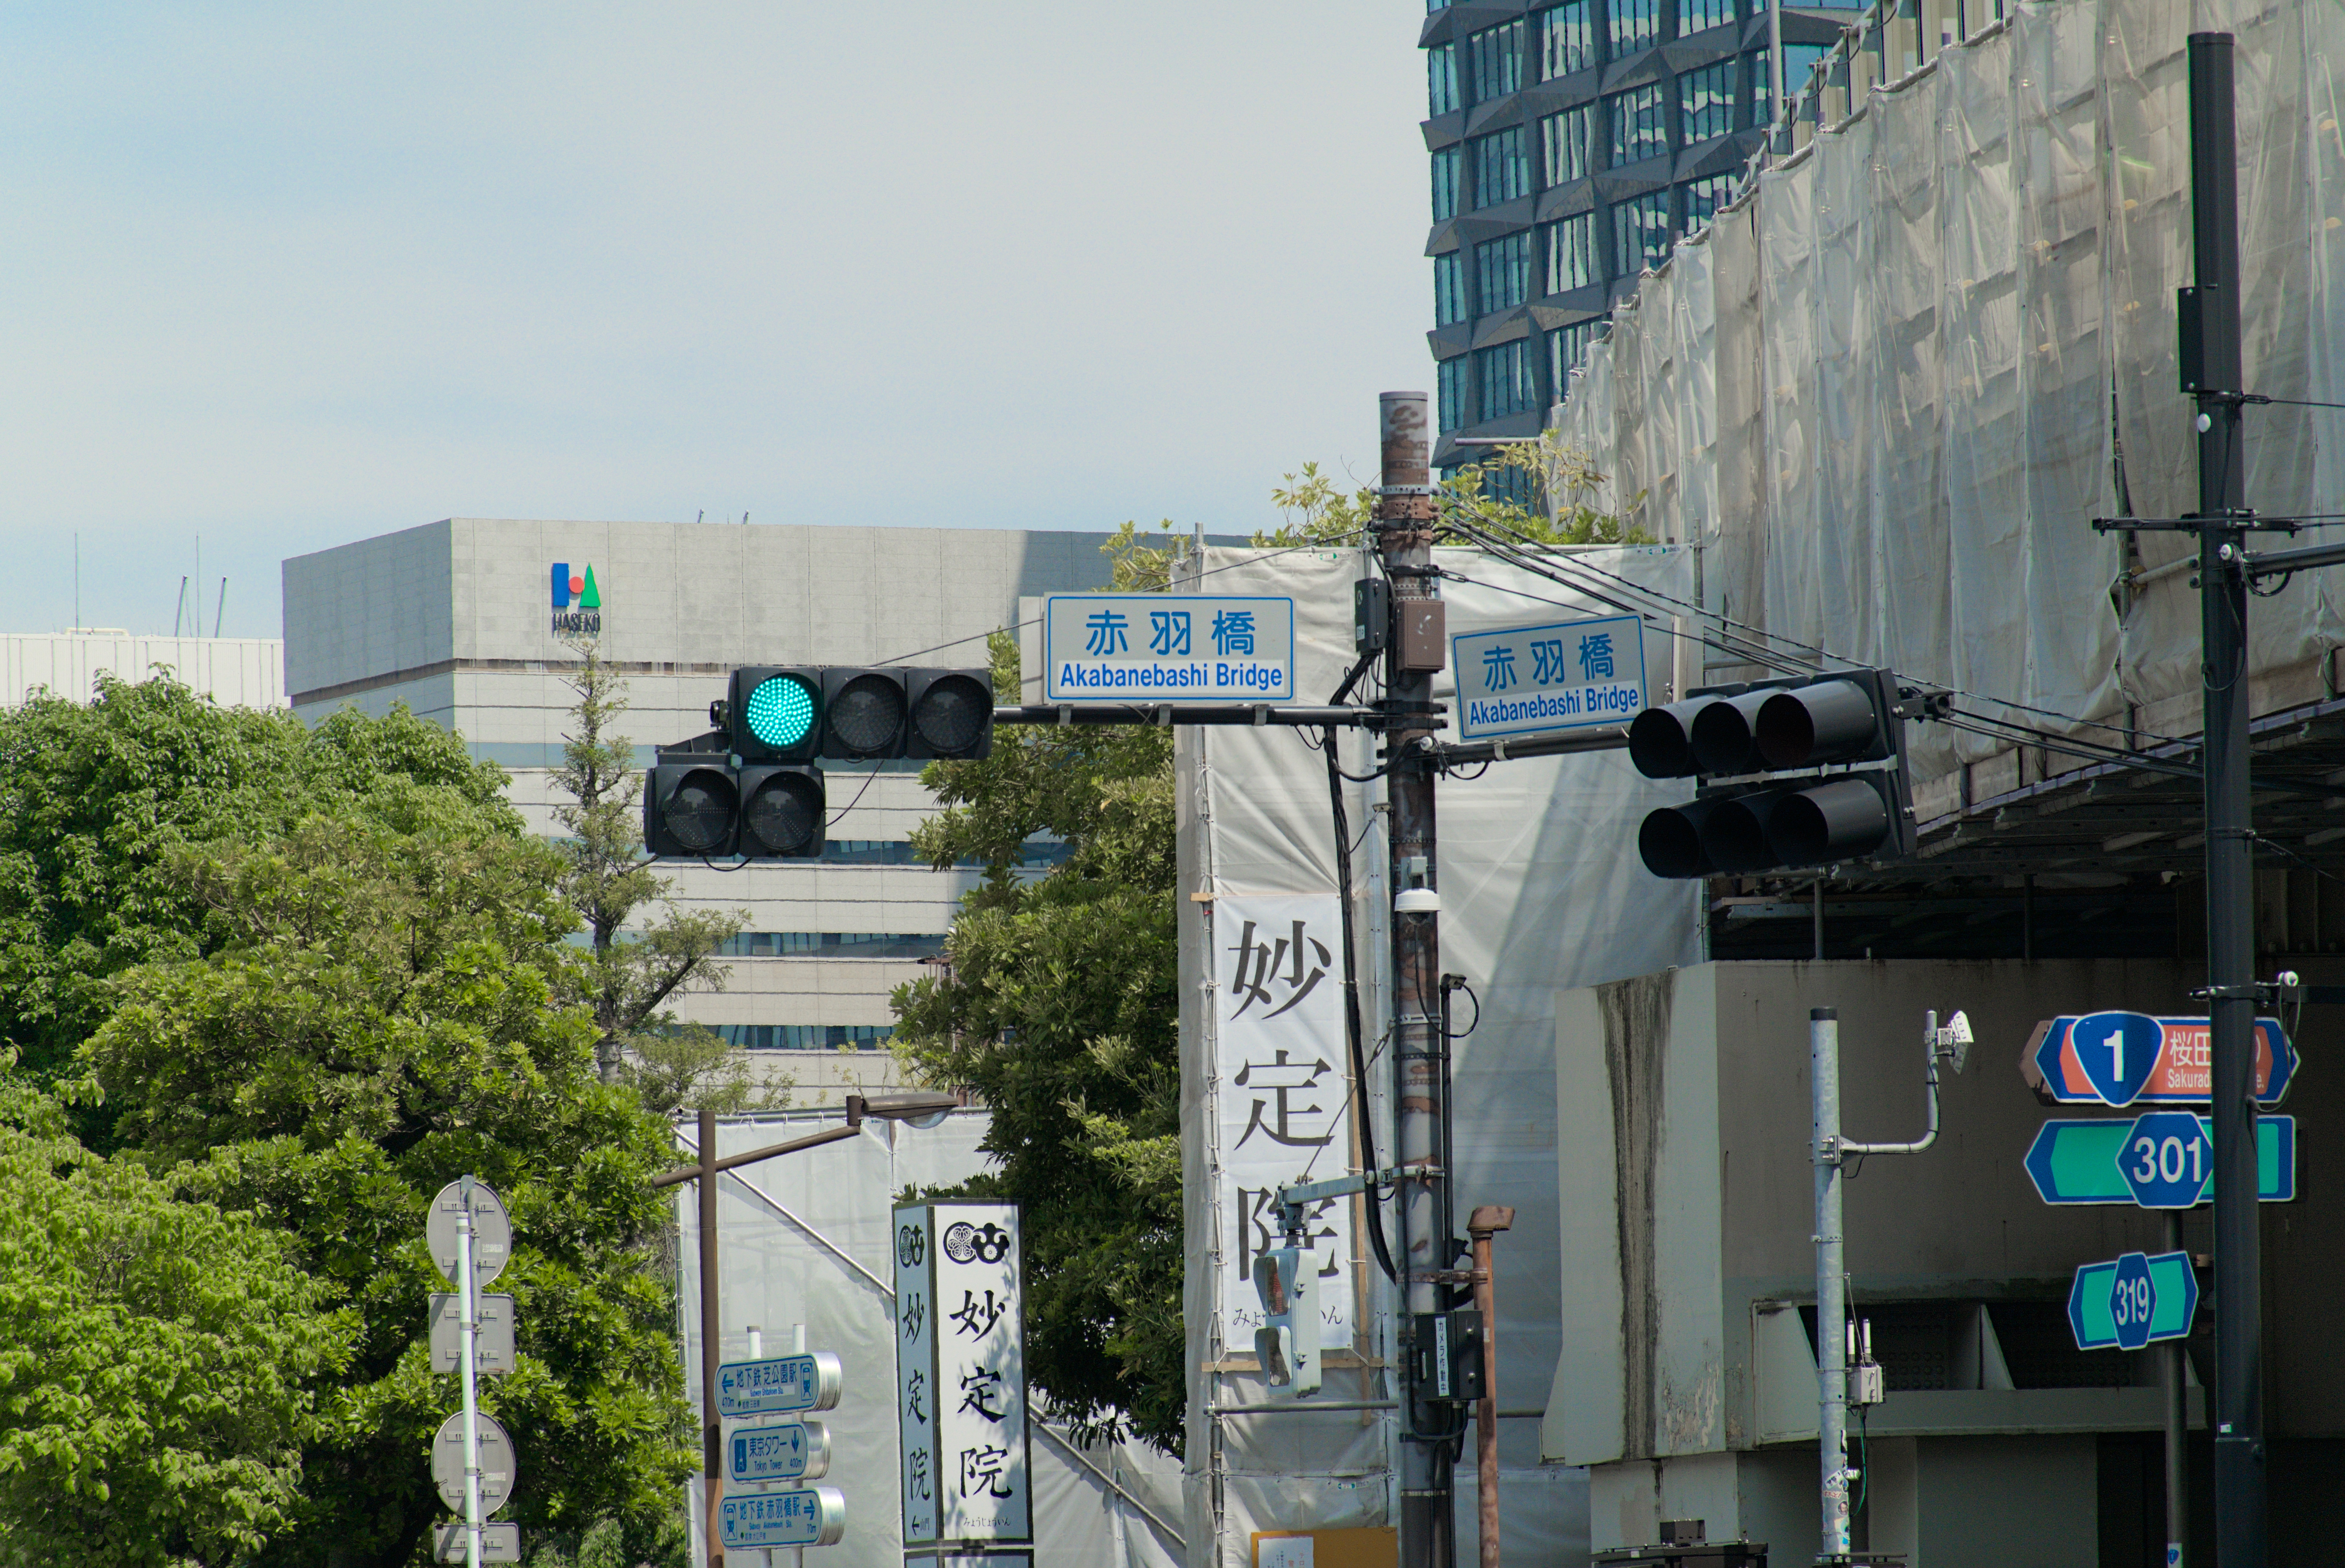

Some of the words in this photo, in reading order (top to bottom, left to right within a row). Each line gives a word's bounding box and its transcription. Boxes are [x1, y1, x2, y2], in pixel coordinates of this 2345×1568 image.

[553, 613, 600, 631] HASEKO
[1085, 609, 1256, 656] 赤羽橋
[1060, 663, 1208, 687] Akabanebashi
[1216, 663, 1283, 691] Bridge
[1482, 633, 1614, 692] 赤羽橋
[1470, 690, 1581, 726] Akabanebashi
[1585, 685, 1638, 713] Bridge
[2102, 1030, 2124, 1082] 1
[2133, 1136, 2202, 1184] 301
[2116, 1276, 2149, 1326] 319
[1438, 1321, 1447, 1394] カメラ作動中
[722, 1397, 734, 1408] 470m
[902, 1290, 931, 1502] 妙定院
[949, 1289, 1013, 1500] 妙定院
[749, 1436, 787, 1458] 東京タワー
[754, 1460, 767, 1473] Tokyo
[769, 1459, 783, 1470] Tower
[790, 1458, 802, 1469] 400m
[807, 1523, 816, 1534] 70m
[963, 1517, 1012, 1527] みょうじょういん
